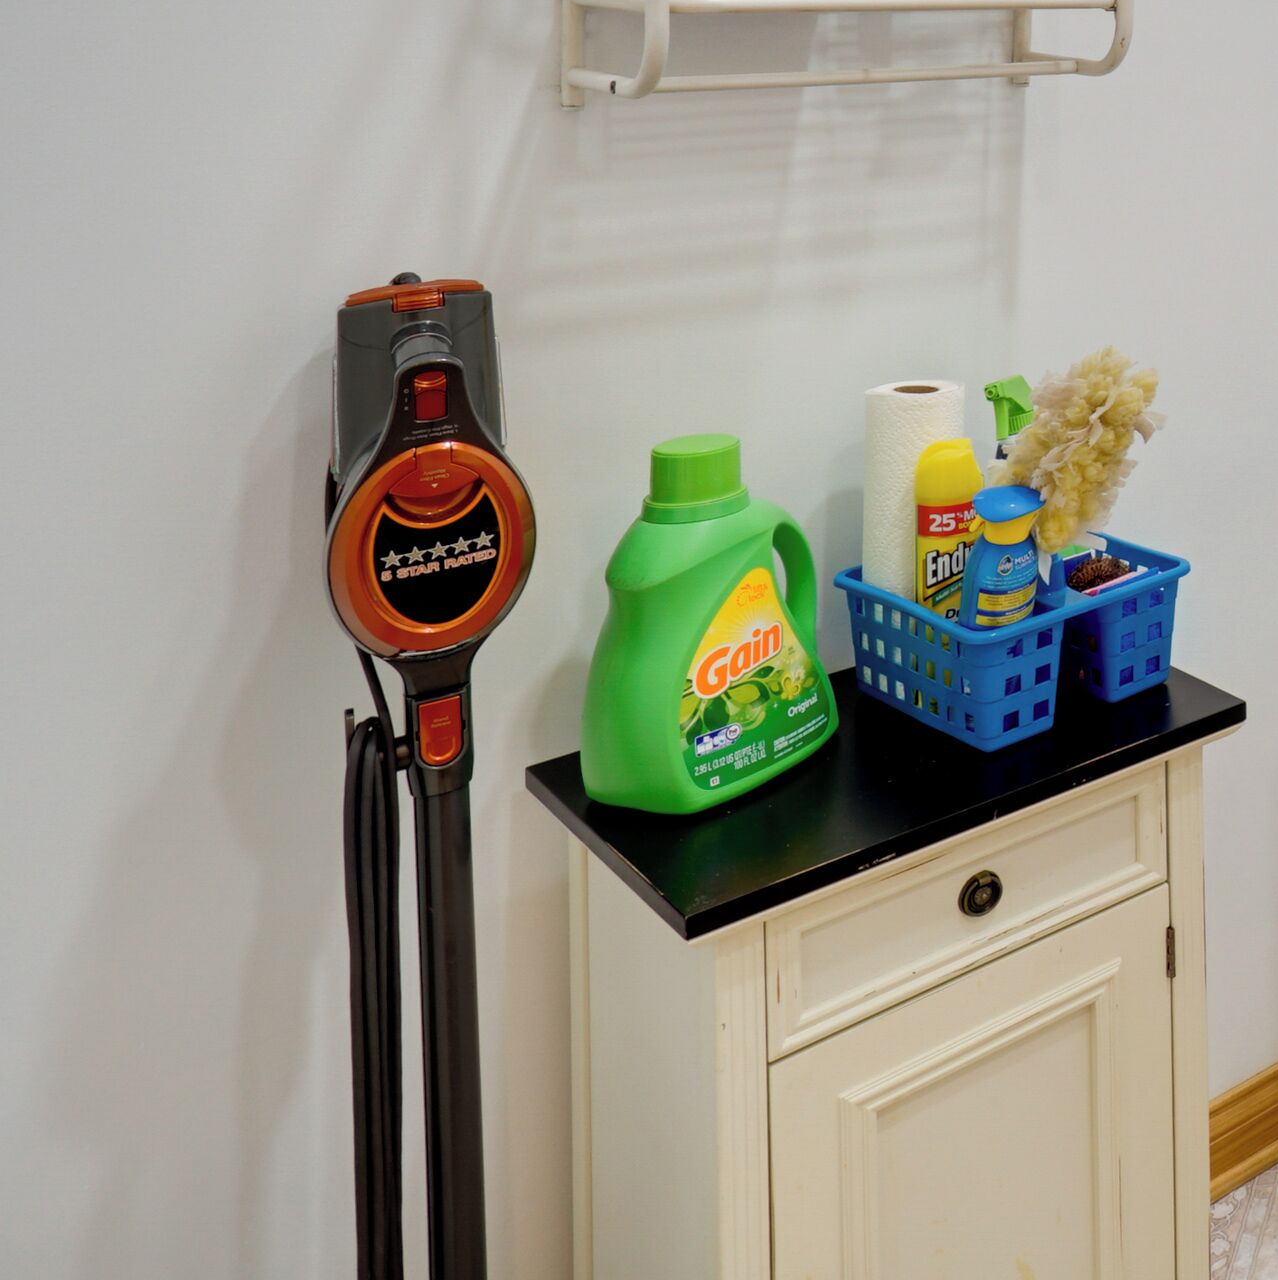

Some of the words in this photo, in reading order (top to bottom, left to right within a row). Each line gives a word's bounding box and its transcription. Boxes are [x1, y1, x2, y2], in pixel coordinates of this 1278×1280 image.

[929, 513, 956, 532] 25
[381, 569, 392, 582] 5
[396, 561, 440, 579] STAR
[444, 548, 497, 569] RATED
[694, 623, 781, 697] Gain
[787, 693, 818, 717] Original
